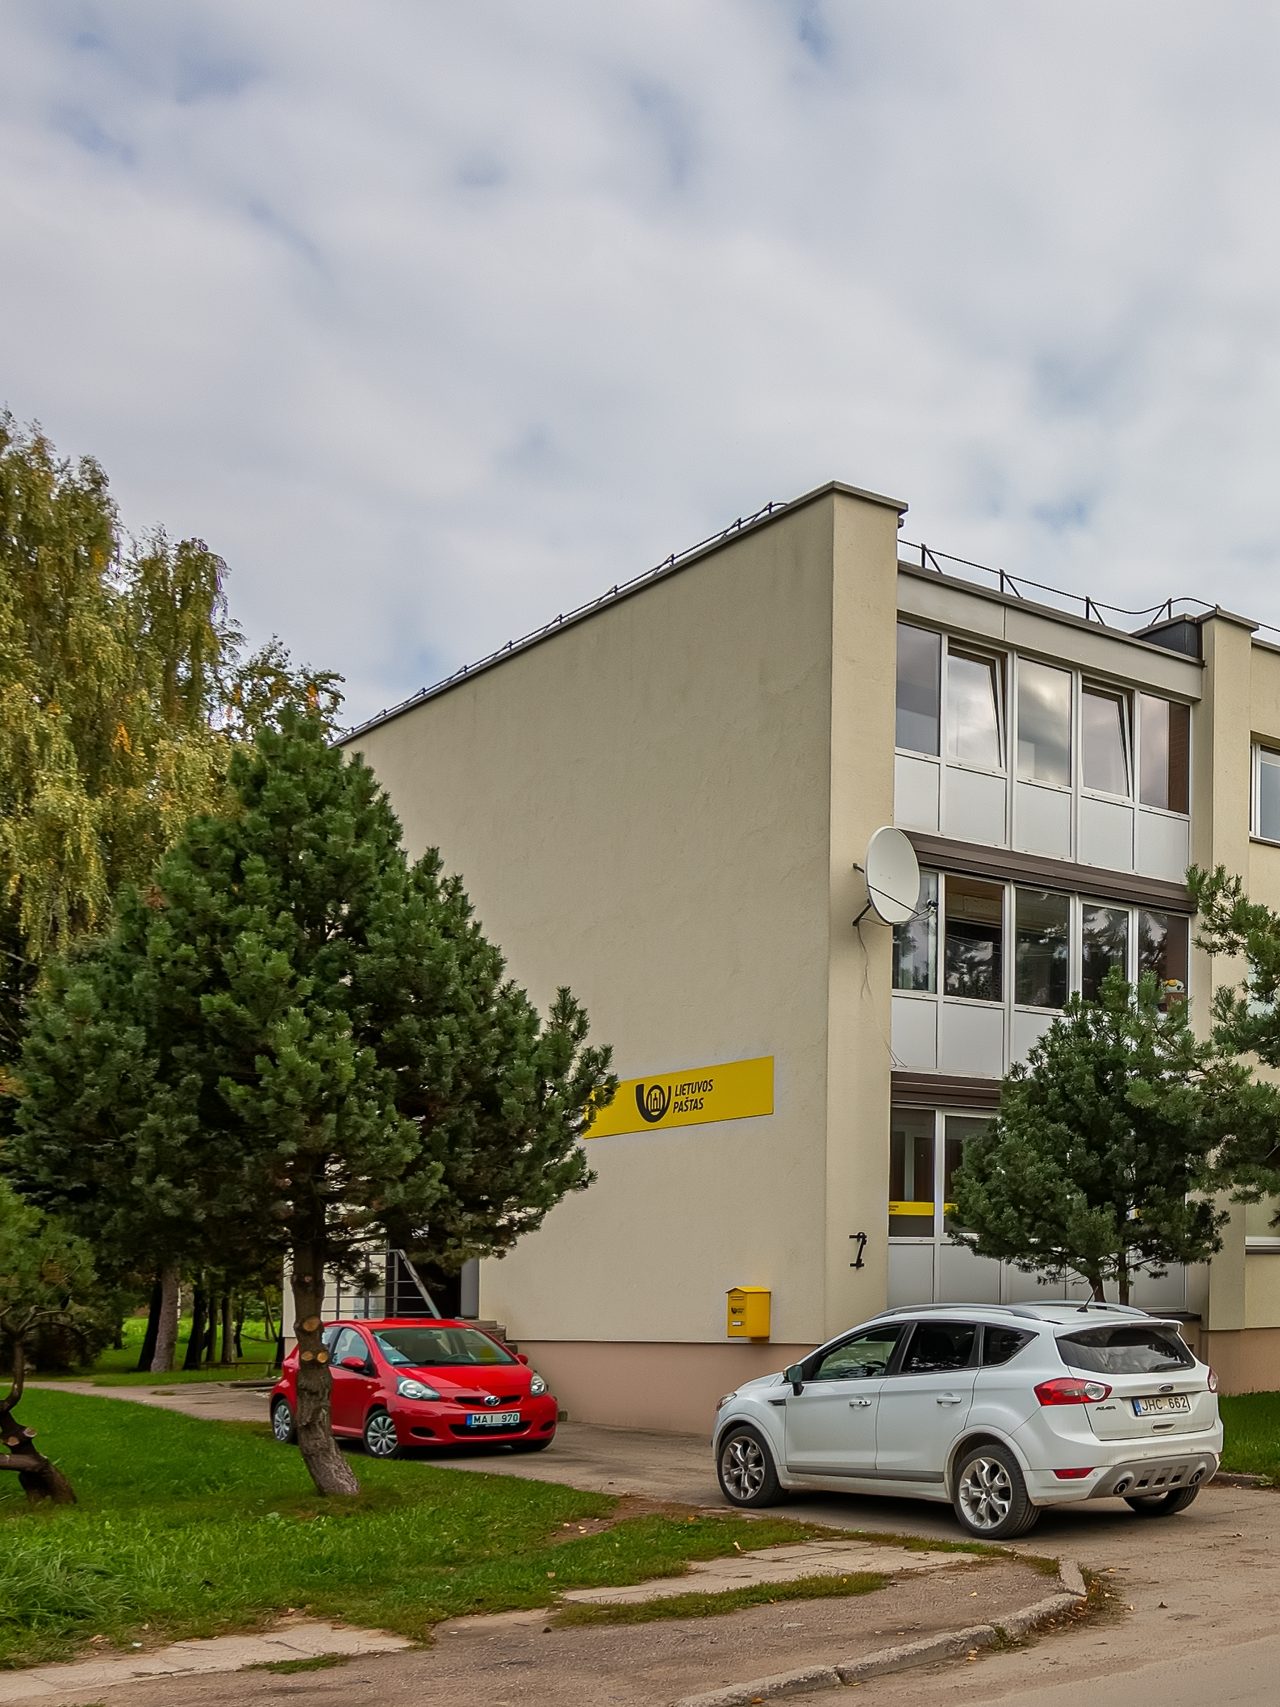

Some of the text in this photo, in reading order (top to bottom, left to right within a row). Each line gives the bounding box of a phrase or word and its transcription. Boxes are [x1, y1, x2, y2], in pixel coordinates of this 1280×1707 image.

[675, 1079, 714, 1097] LIETUVOS
[673, 1097, 704, 1113] PAŠTAS
[1142, 1397, 1188, 1411] JHC 662
[473, 1414, 519, 1424] MAI 970
